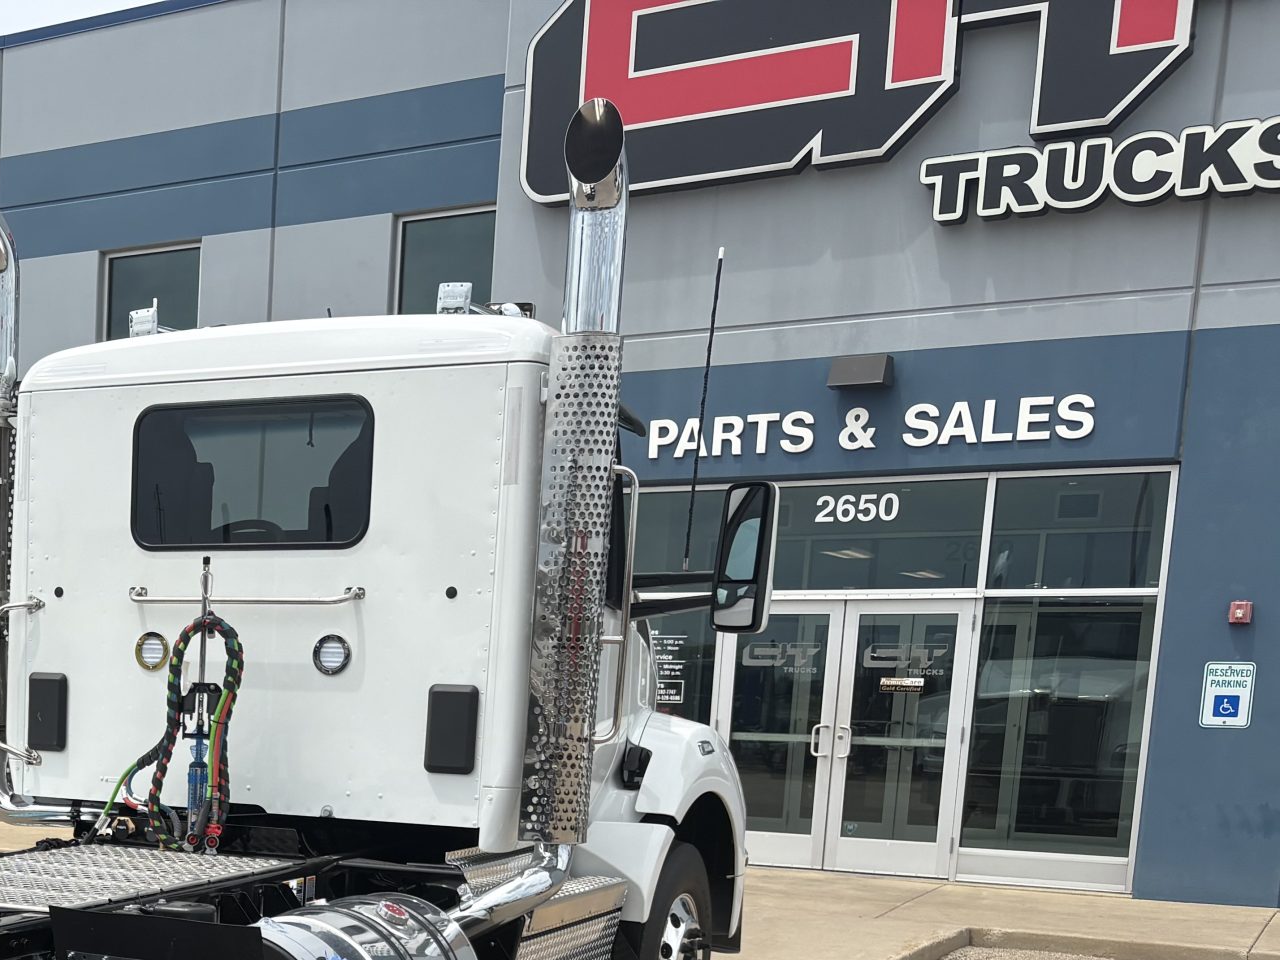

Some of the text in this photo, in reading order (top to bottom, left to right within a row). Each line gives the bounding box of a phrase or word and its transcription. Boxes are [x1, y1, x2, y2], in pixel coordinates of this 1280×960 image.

[648, 394, 1095, 459] PARTS & SALES
[814, 492, 900, 523] 2650
[742, 643, 821, 667] CIT
[863, 643, 949, 668] CIT
[784, 666, 818, 675] TRUCKS
[907, 668, 945, 677] TRUCKS
[1209, 668, 1251, 677] RESERVED
[1210, 680, 1247, 688] PARKING
